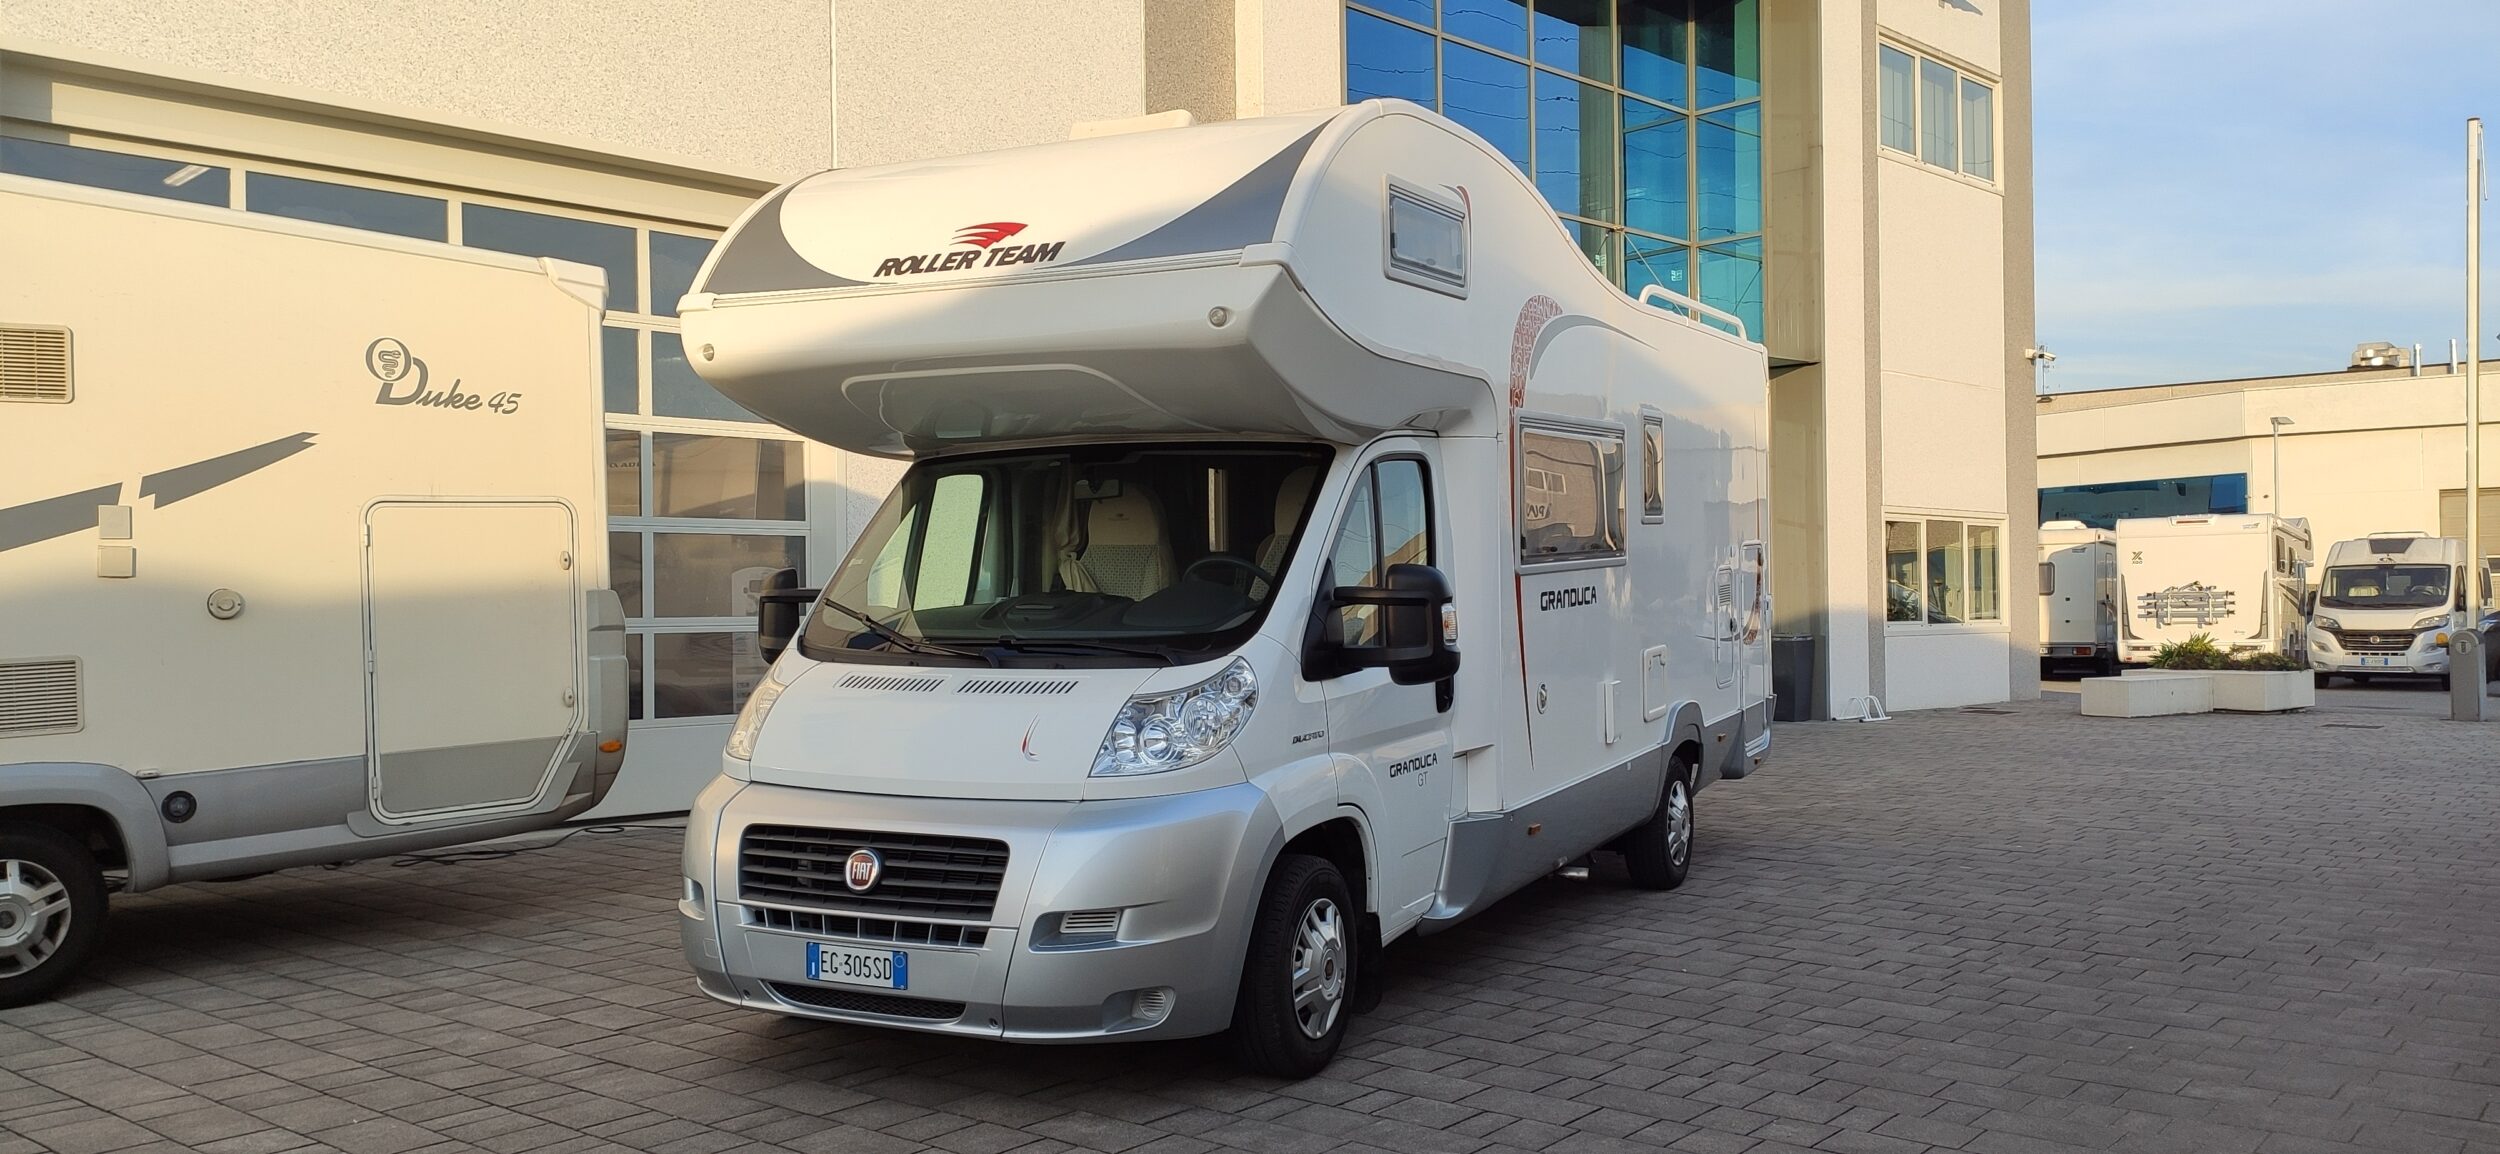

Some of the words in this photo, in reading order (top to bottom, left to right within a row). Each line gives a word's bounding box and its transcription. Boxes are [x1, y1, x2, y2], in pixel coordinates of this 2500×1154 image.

[873, 250, 982, 277] ROLLER
[984, 241, 1066, 267] TEAM
[376, 357, 483, 411] Duke
[488, 392, 522, 415] 45
[1540, 586, 1597, 611] GRANDUCA
[1390, 753, 1438, 778] GRANDUCA
[1418, 772, 1428, 787] GT
[852, 861, 872, 881] FIAT
